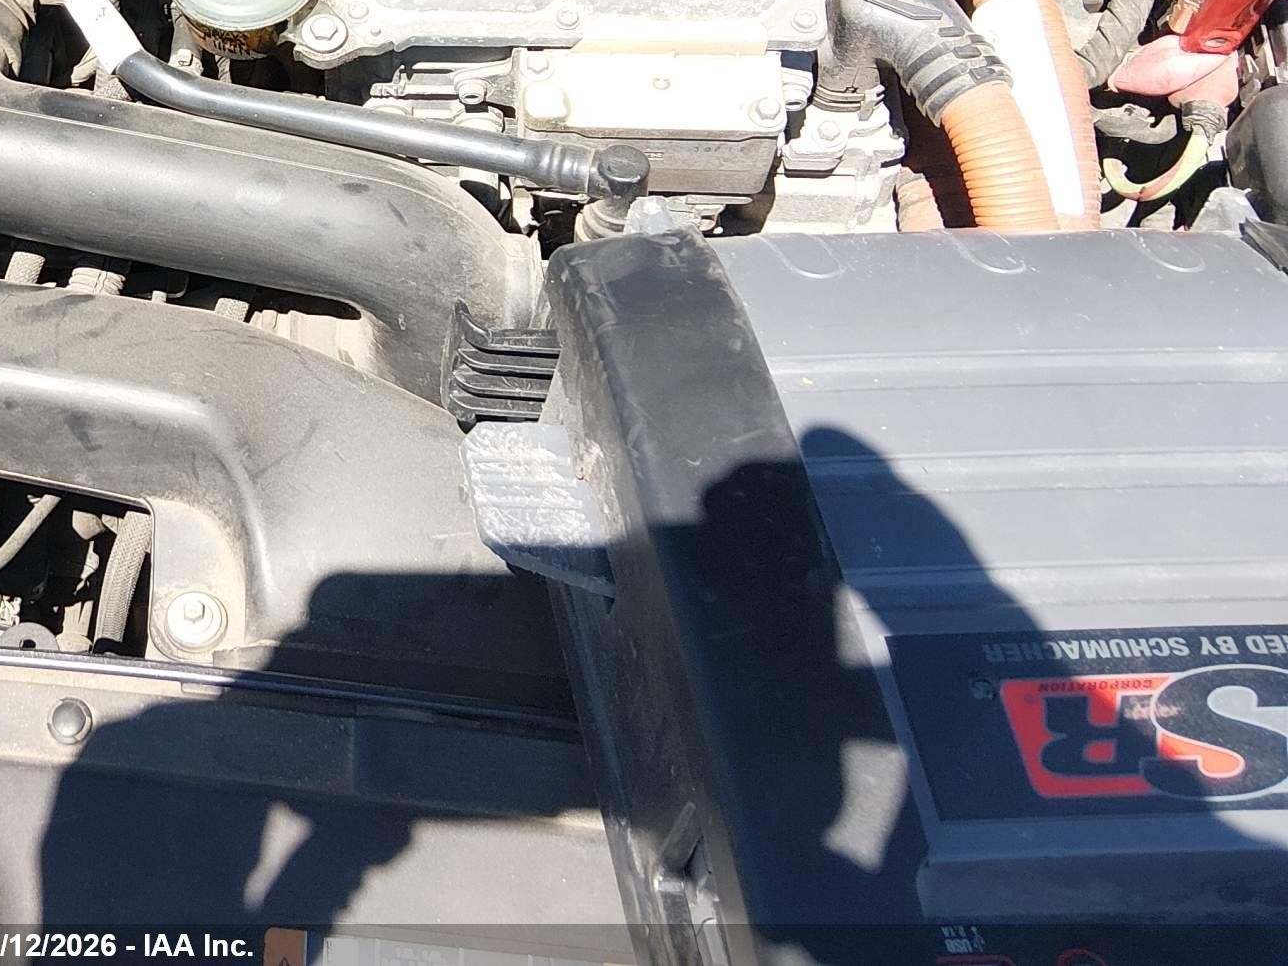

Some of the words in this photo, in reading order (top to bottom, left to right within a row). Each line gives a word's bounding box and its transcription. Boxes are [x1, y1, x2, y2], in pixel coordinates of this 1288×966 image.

[982, 636, 1191, 663] SCHUMACHER
[1199, 635, 1239, 655] BY
[1038, 679, 1153, 692] CORPORATION
[944, 938, 973, 953] USB
